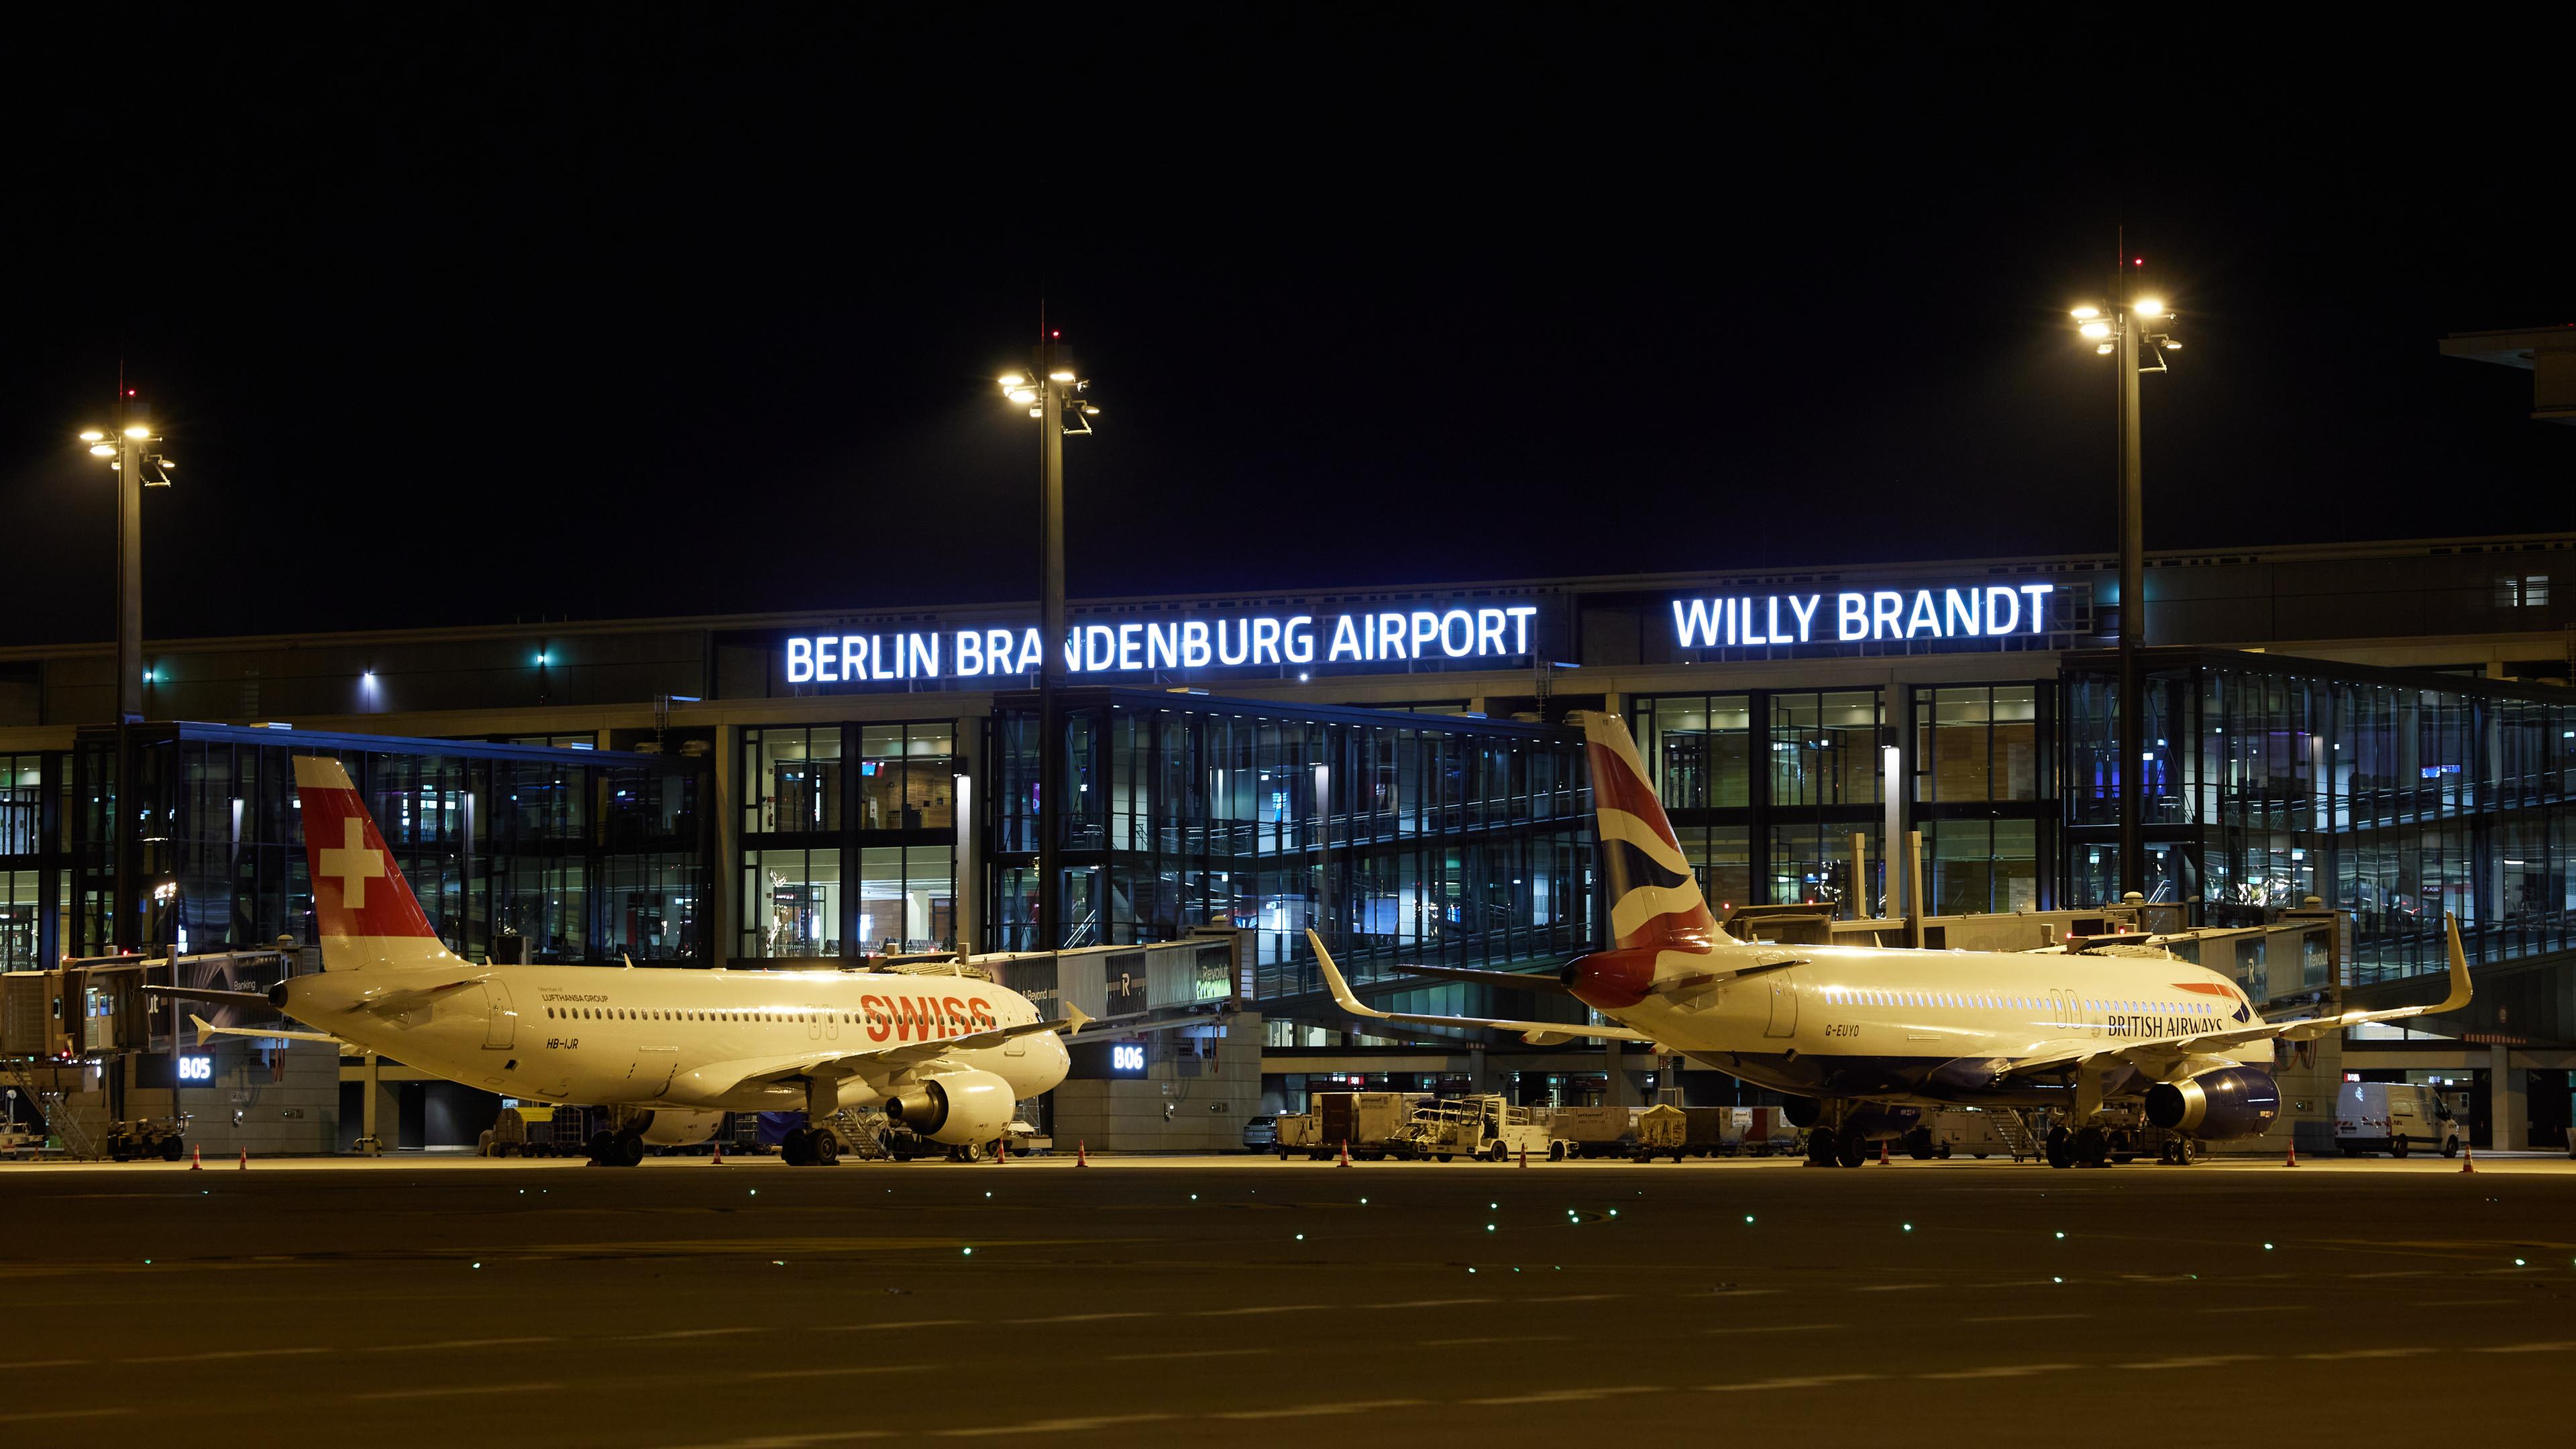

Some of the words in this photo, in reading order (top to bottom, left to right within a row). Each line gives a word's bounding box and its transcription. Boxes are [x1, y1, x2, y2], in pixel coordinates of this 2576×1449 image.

[1672, 594, 1821, 647] WILLY
[1839, 584, 2054, 641] BRANDT
[787, 632, 939, 683] BERLIN
[957, 616, 1313, 676] BRANDENBURG
[1328, 606, 1537, 661] AIRPORT
[2308, 949, 2328, 967] Revolut
[1202, 963, 1228, 981] Revolut
[234, 979, 256, 991] Banking
[541, 994, 584, 1002] LUFTHANSA
[584, 995, 608, 1003] GROUP
[1028, 987, 1047, 1004] Beyond
[860, 994, 997, 1042] SWISS
[2108, 1015, 2162, 1038] BRITISH
[2166, 1017, 2222, 1038] AIRWAYS
[1825, 1024, 1860, 1036] G-EUYO
[546, 1038, 579, 1050] HB-IJR
[1114, 1046, 1143, 1069] B06
[179, 1057, 211, 1079] B05
